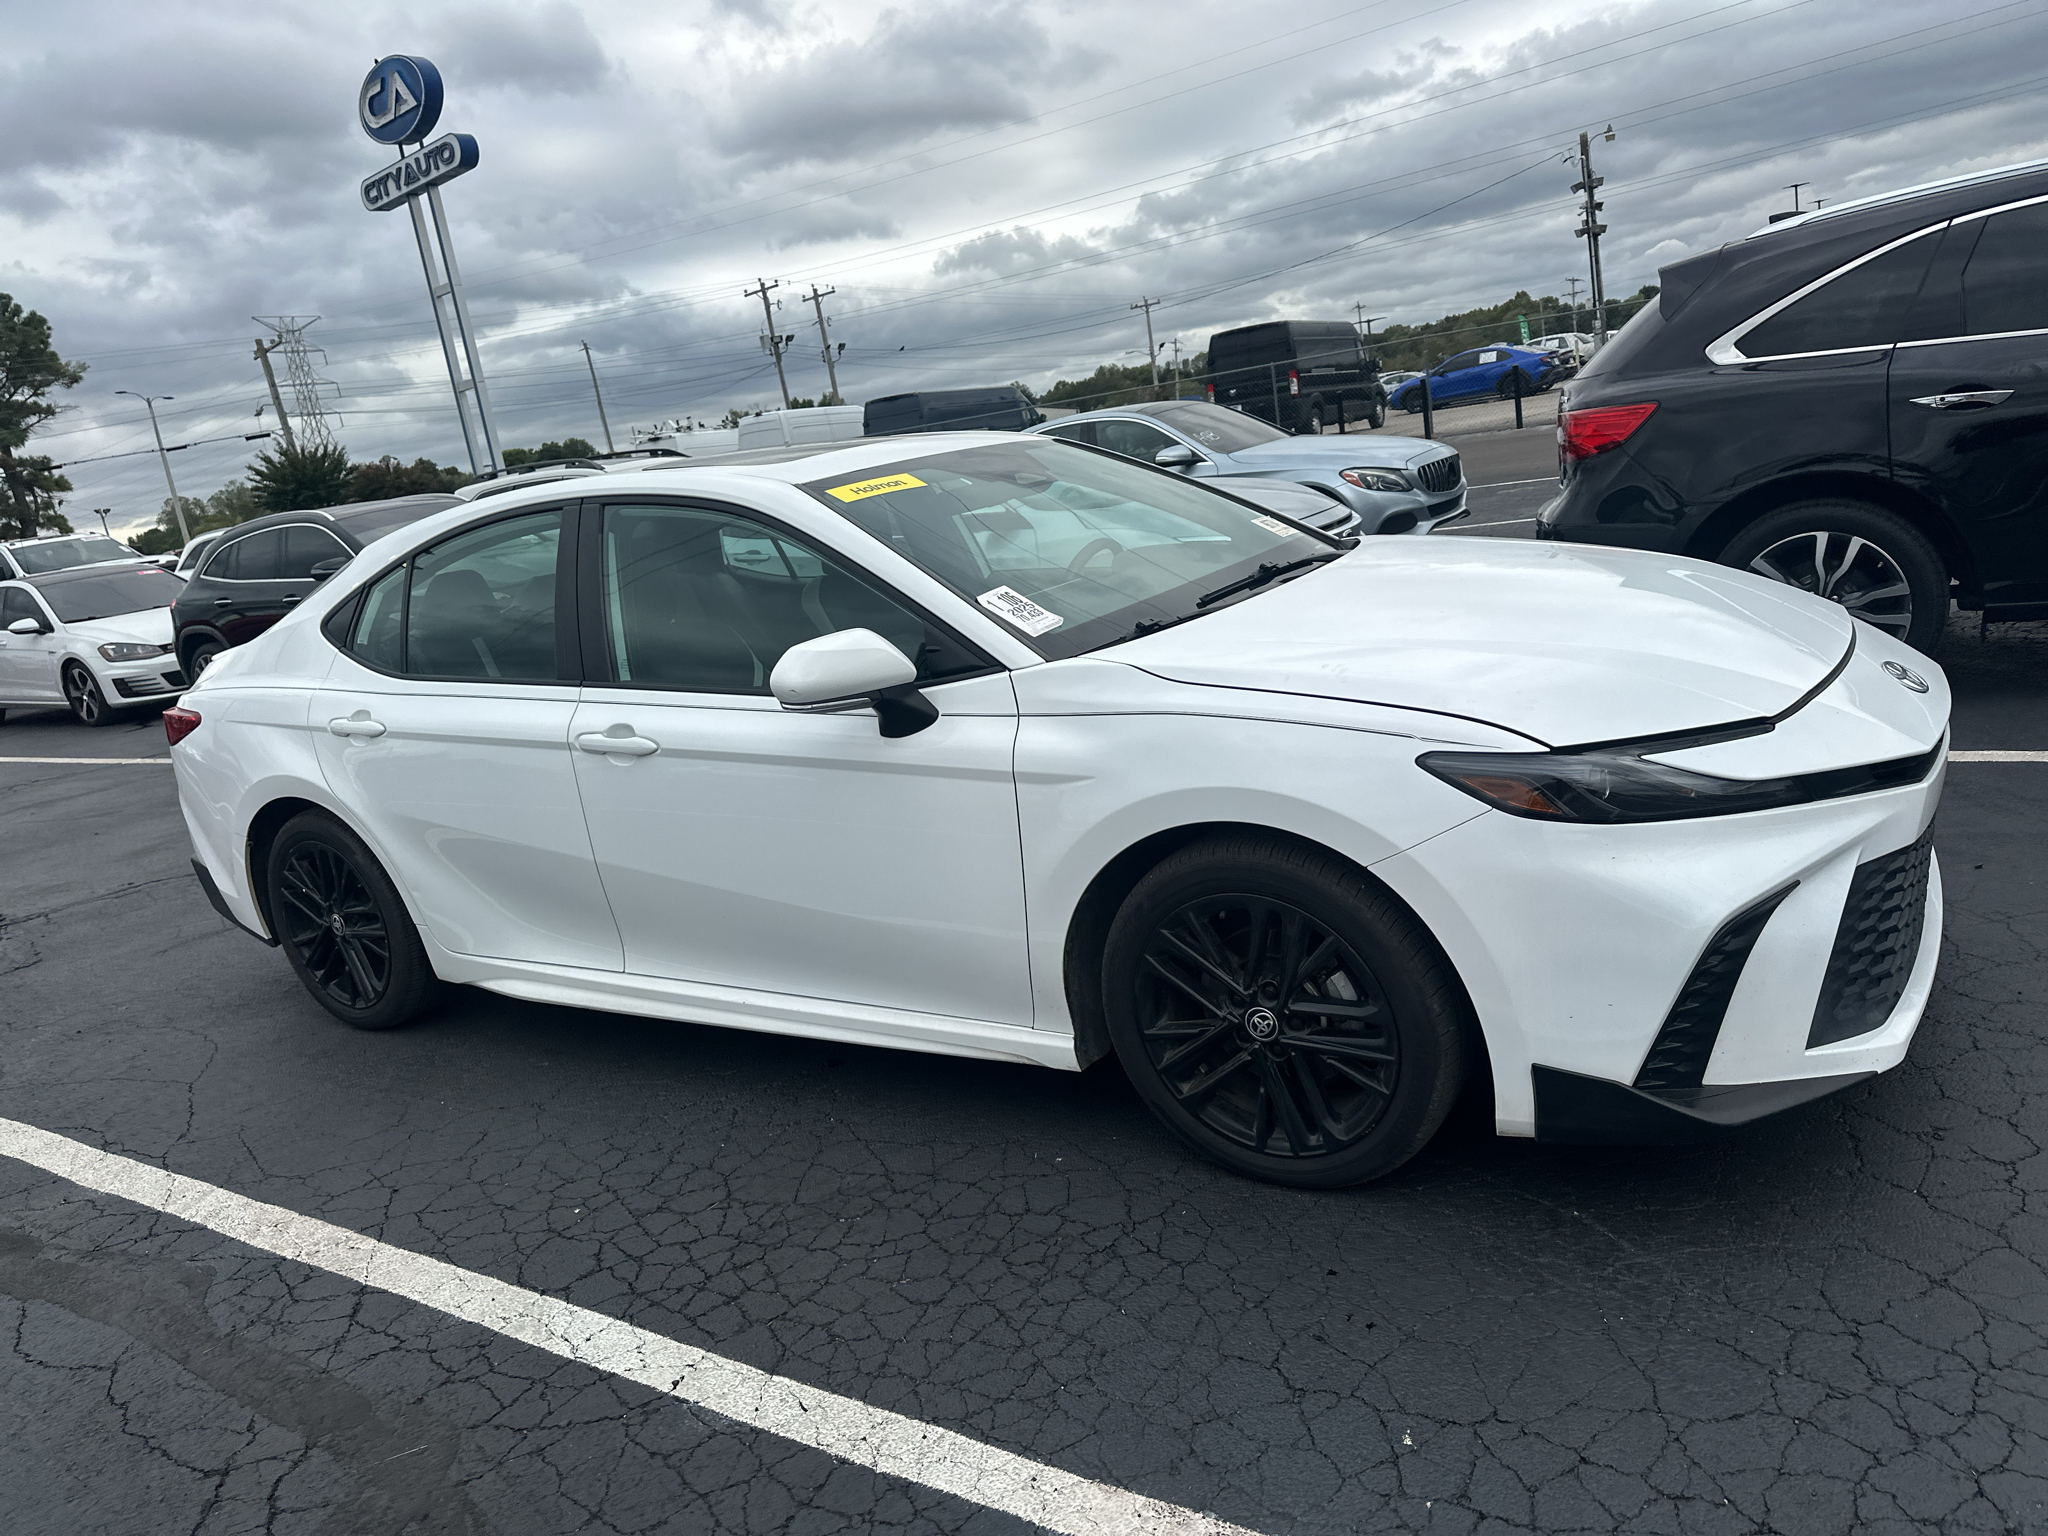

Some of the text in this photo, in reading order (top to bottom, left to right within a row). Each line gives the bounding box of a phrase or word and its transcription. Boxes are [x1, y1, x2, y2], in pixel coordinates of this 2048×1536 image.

[362, 69, 418, 129] CA
[849, 479, 908, 495] Holman
[1006, 601, 1035, 617] 2025
